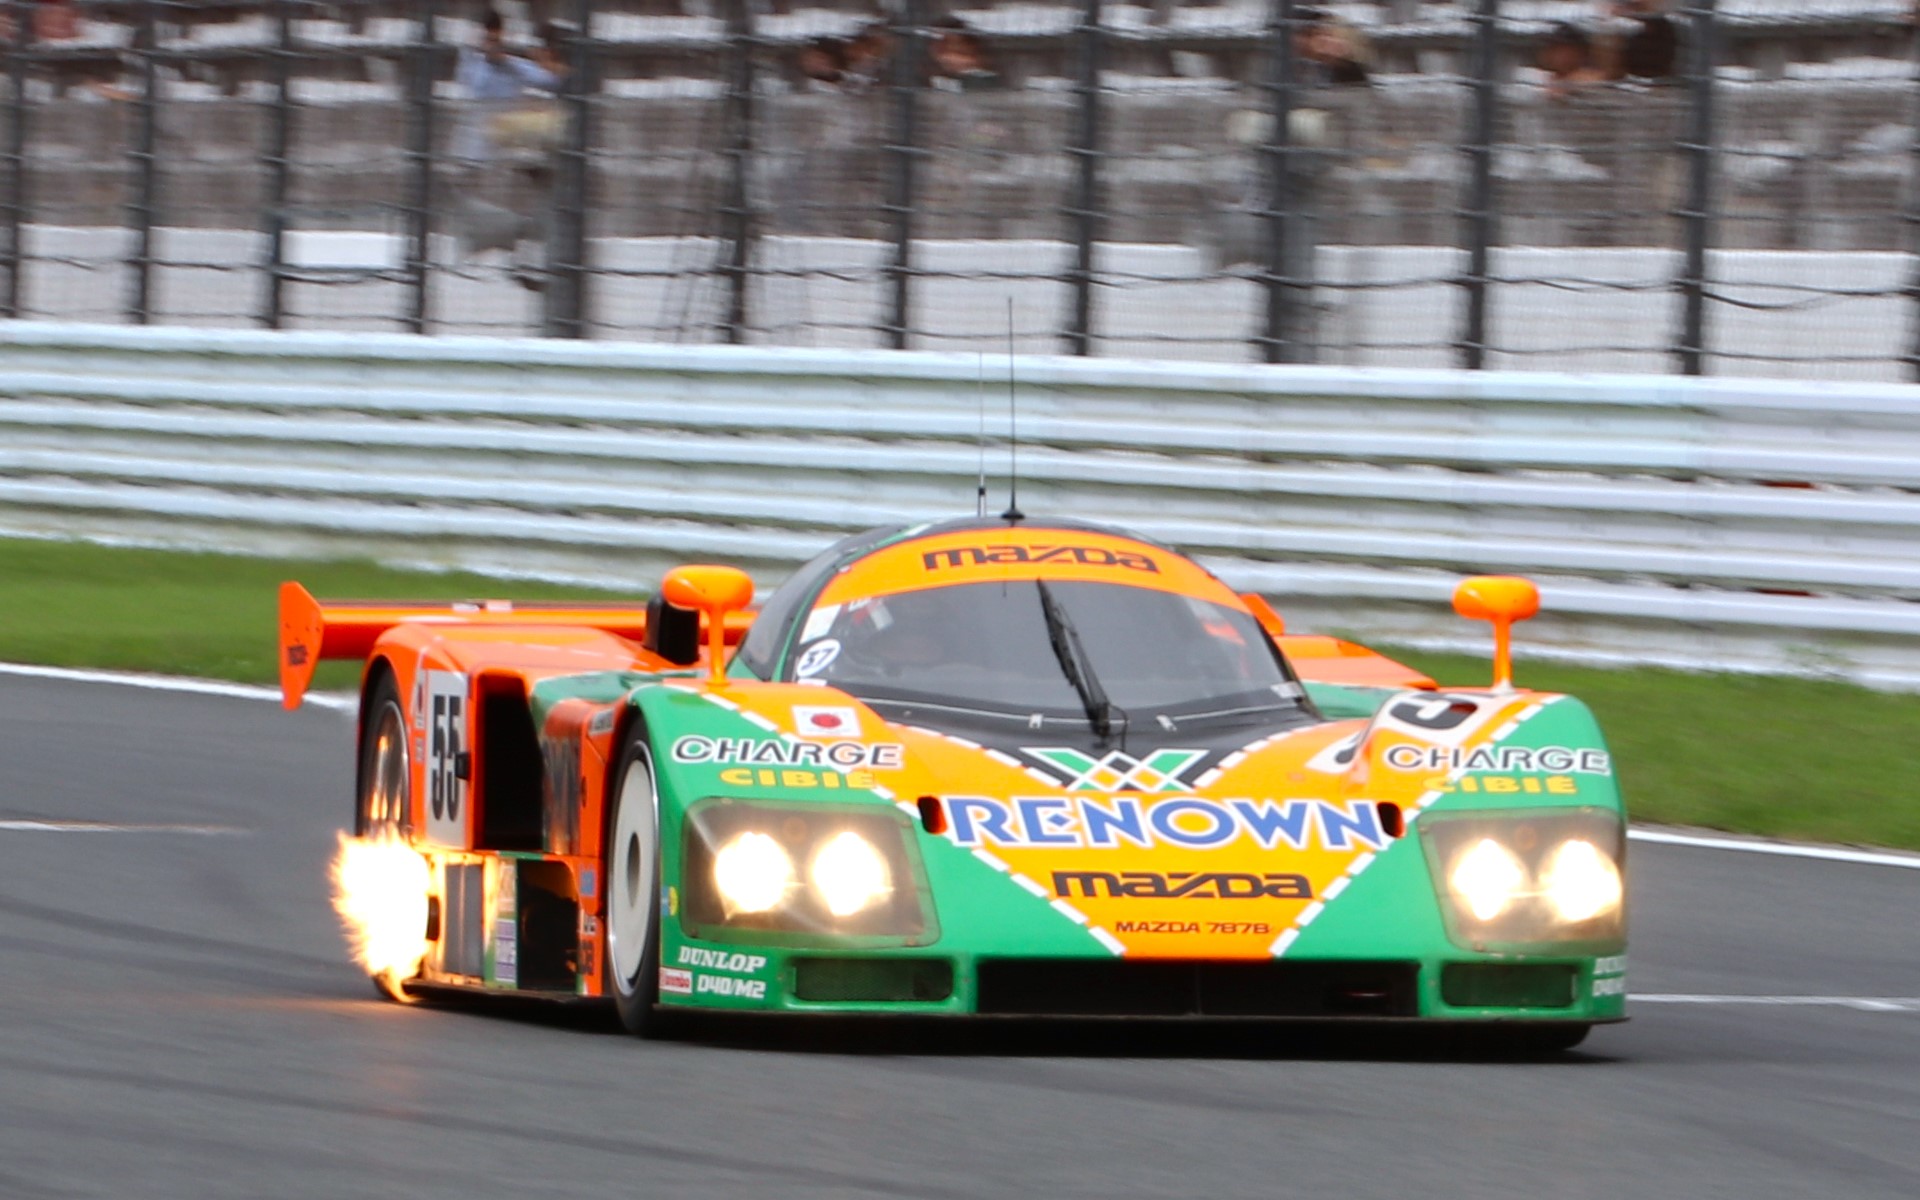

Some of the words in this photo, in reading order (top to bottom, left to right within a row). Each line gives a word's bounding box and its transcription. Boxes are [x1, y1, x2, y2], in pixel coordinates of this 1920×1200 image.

[432, 694, 461, 822] 55
[672, 735, 904, 768] CHARGE
[1386, 744, 1611, 775] CHARGE
[946, 797, 1388, 849] RENOWN
[1115, 921, 1200, 933] MAZDA
[678, 946, 766, 973] DUNLOP
